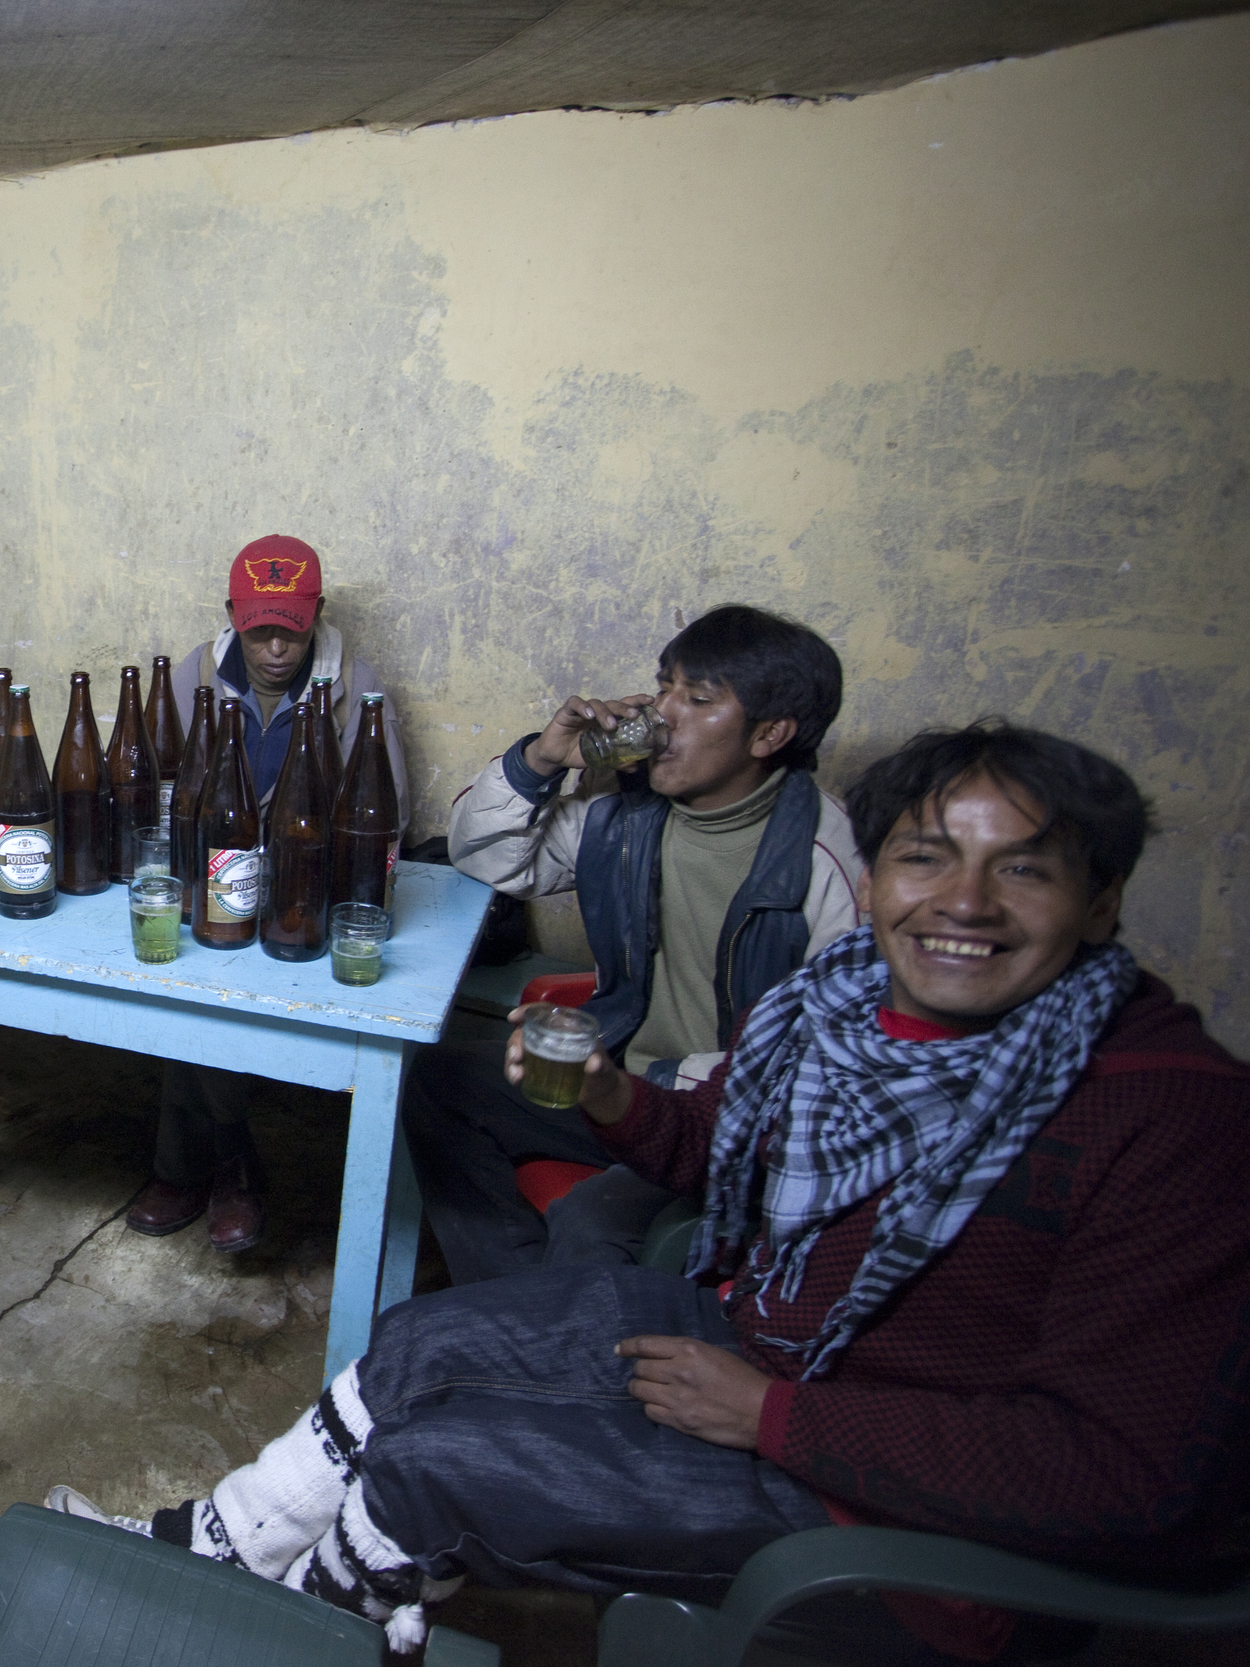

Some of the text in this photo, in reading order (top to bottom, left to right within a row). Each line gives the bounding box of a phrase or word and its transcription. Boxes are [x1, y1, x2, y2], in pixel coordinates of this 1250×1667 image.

[261, 608, 304, 629] ANGELES
[6, 853, 45, 865] POTOSINA
[213, 851, 234, 868] LITRO
[11, 865, 40, 874] Pilsener
[222, 902, 245, 915] CERVECERIA
